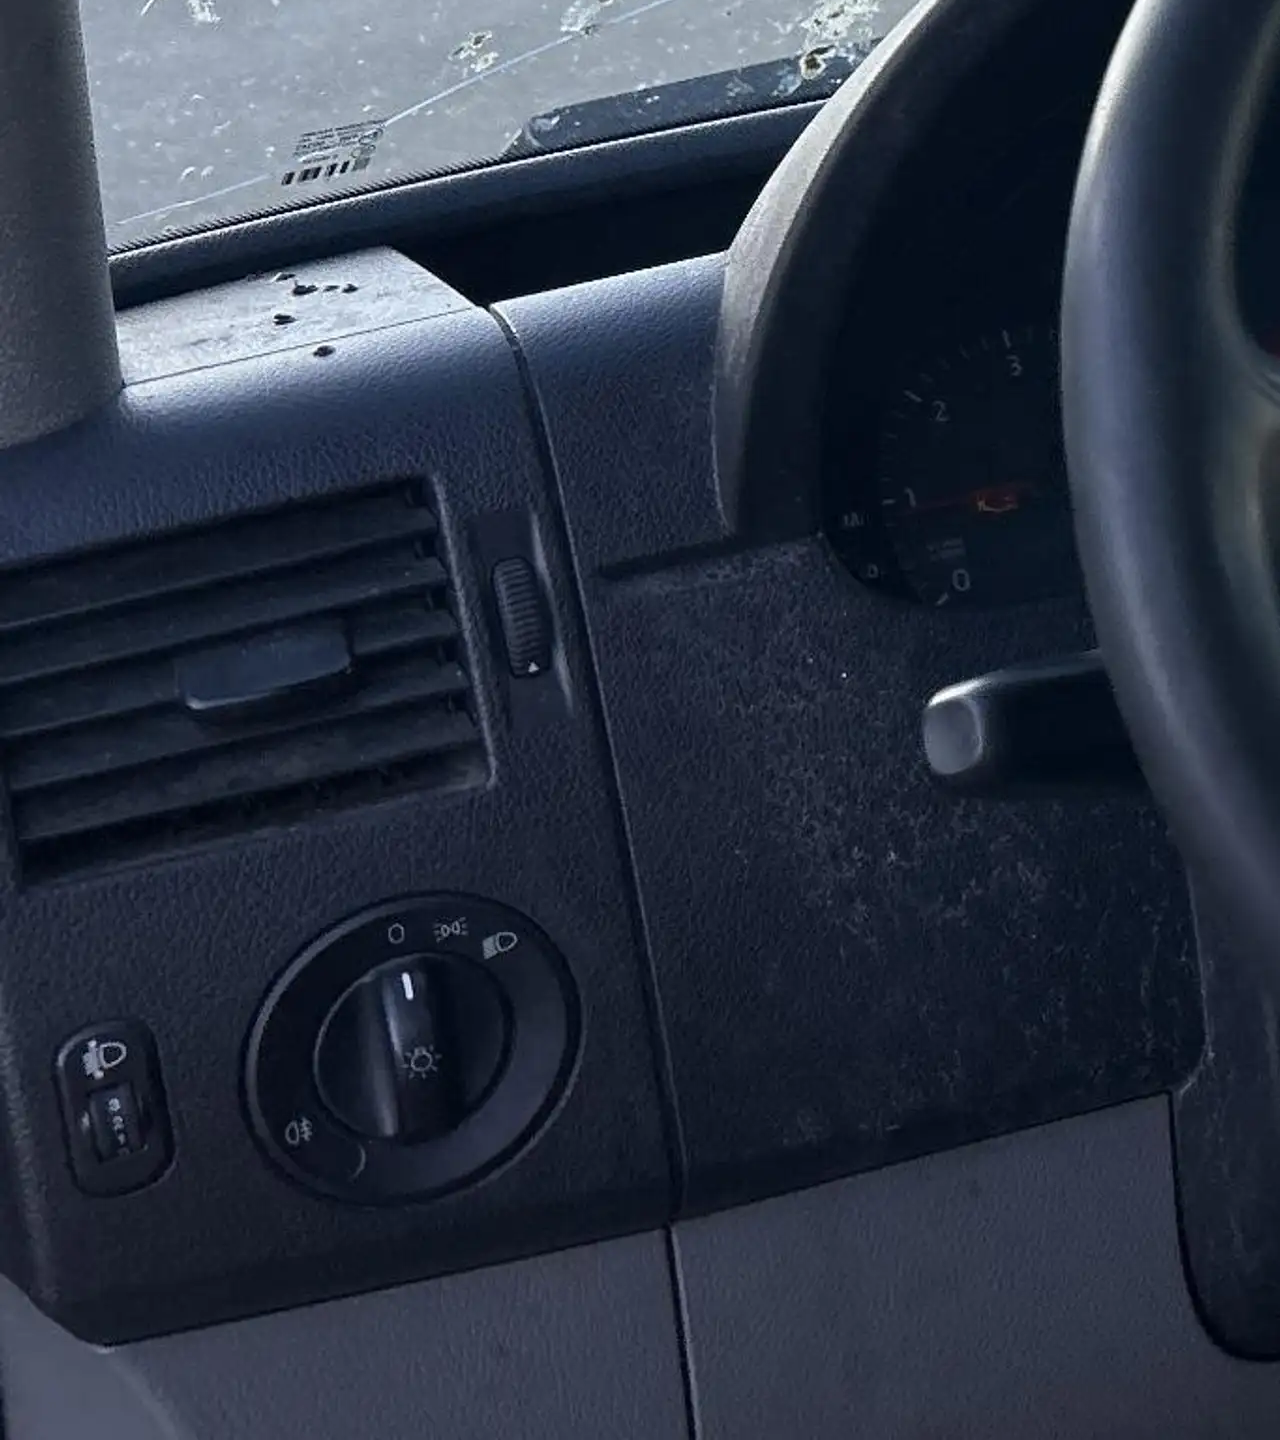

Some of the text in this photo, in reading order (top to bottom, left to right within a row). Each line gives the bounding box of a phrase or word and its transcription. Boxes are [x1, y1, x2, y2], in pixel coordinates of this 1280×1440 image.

[1004, 353, 1023, 377] 3
[930, 399, 951, 424] 2
[951, 568, 973, 593] 0
